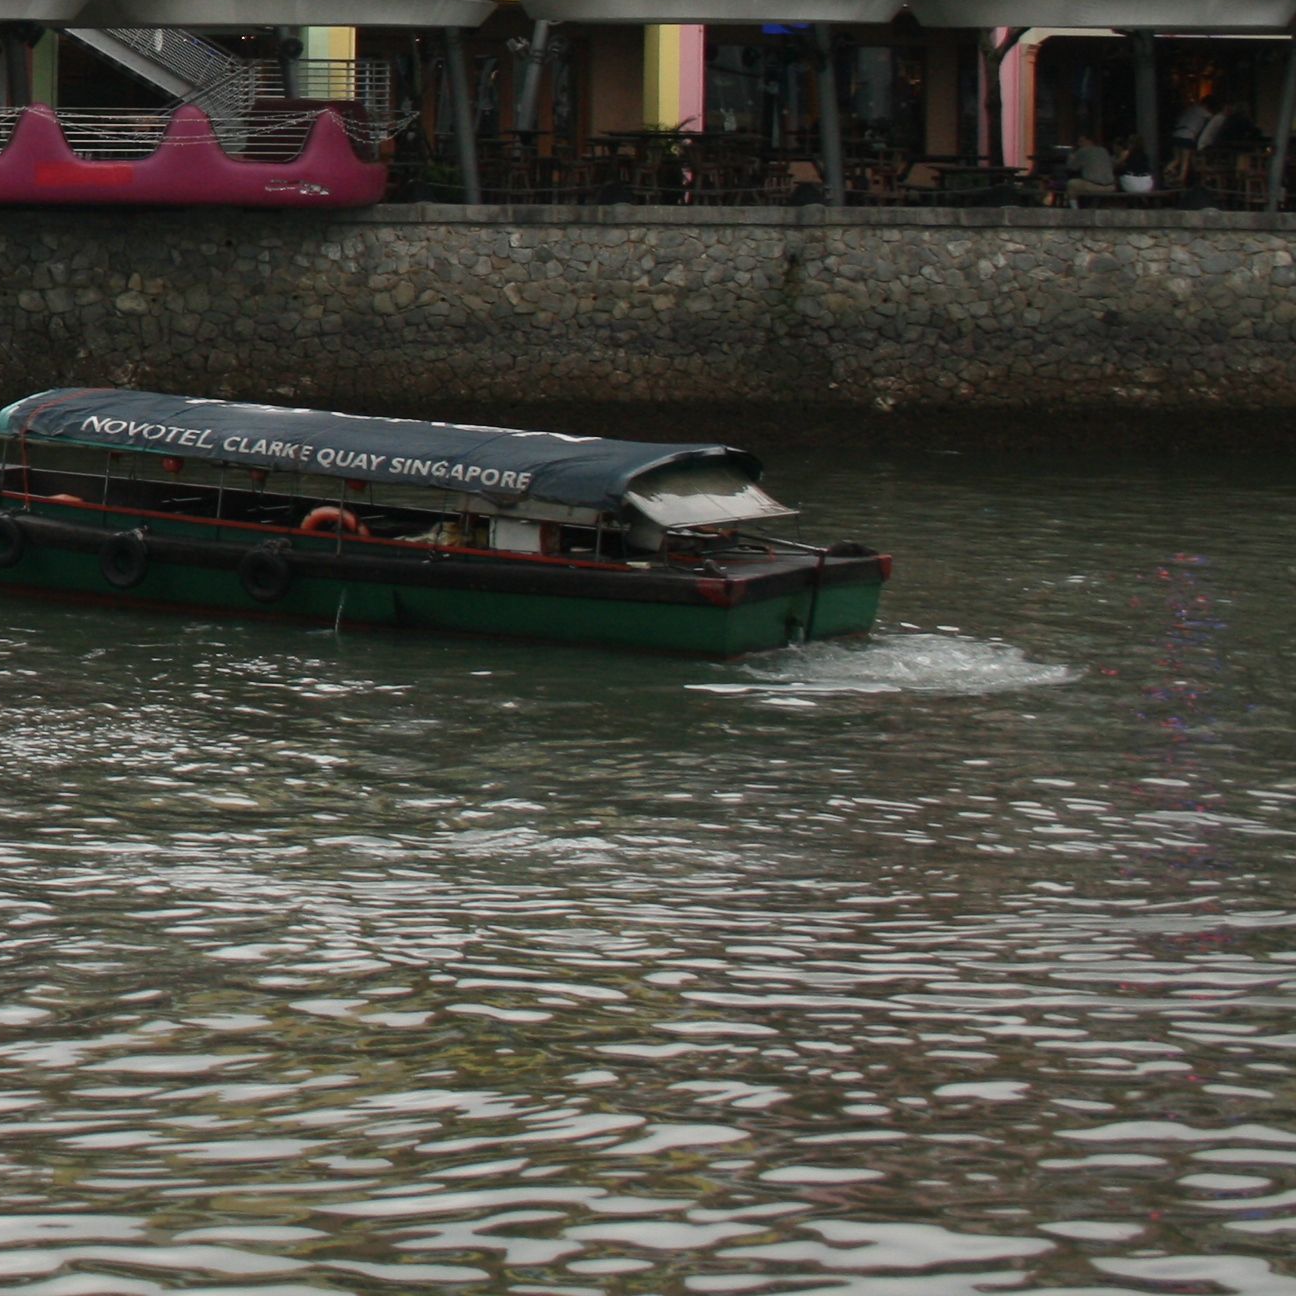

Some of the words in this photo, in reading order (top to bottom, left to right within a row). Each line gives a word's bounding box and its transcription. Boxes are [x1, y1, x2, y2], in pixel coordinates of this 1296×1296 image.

[80, 415, 214, 449] NOVOTEL
[222, 436, 313, 461] CLARKE
[316, 447, 386, 472] QUAY
[388, 456, 532, 490] SINGAPORE
